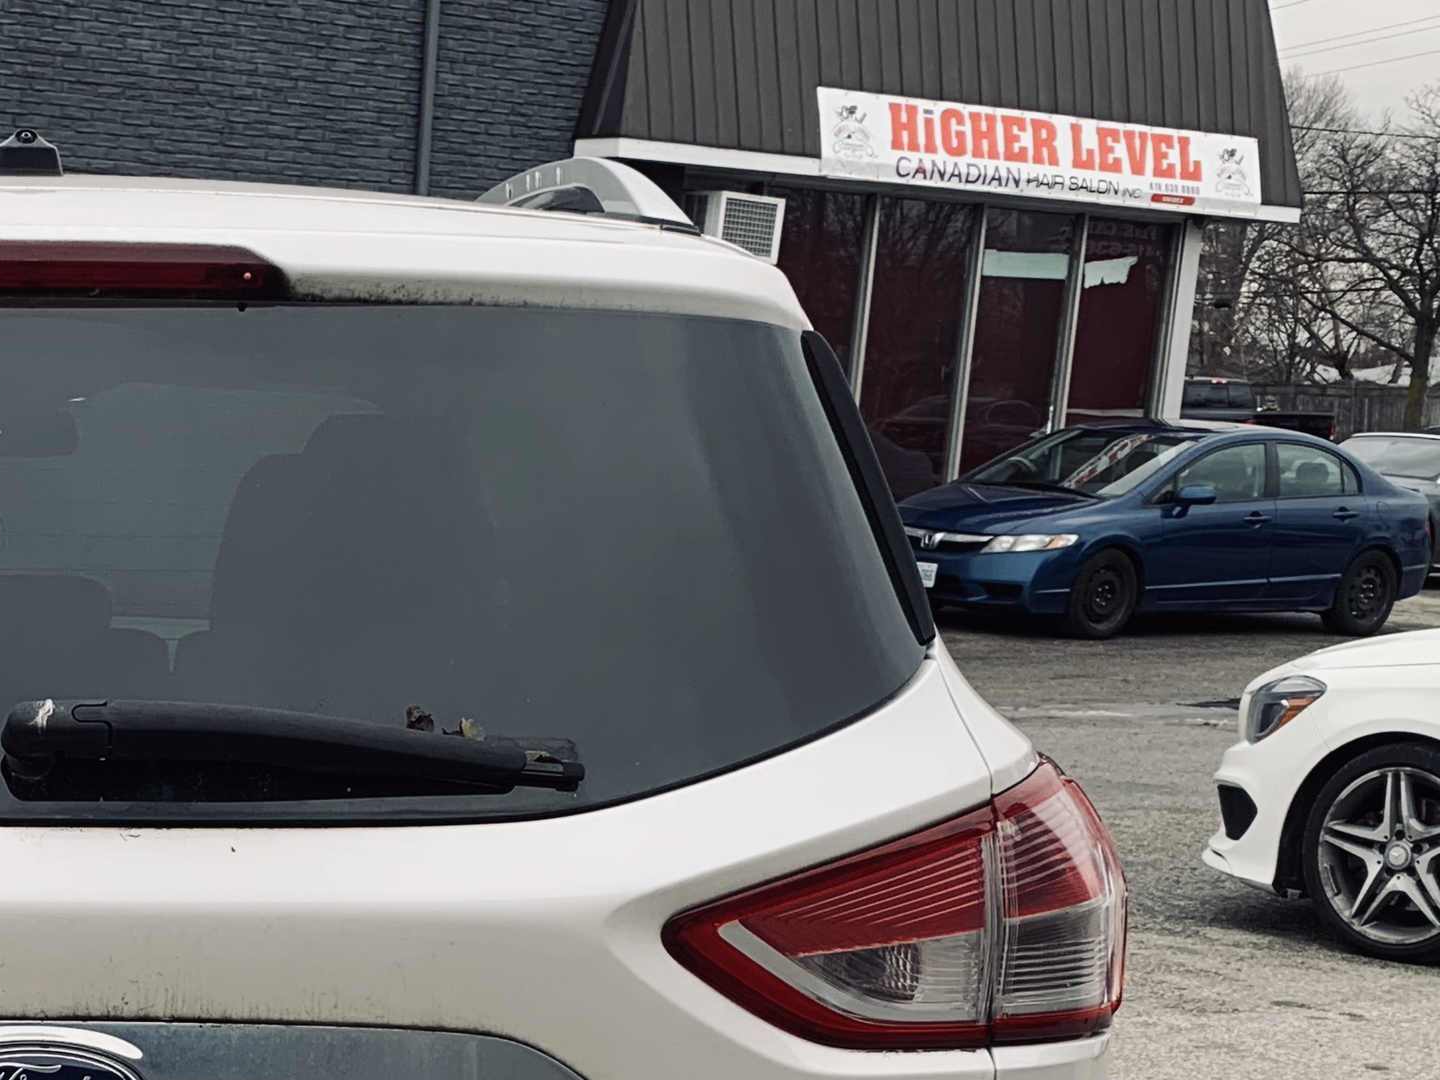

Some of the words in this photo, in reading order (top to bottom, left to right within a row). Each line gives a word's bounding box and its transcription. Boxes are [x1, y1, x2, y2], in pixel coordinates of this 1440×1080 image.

[895, 156, 1023, 189] CANADIAN
[1026, 172, 1065, 190] HAIR
[1068, 176, 1119, 195] SALON
[1070, 122, 1203, 182] LEVEL
